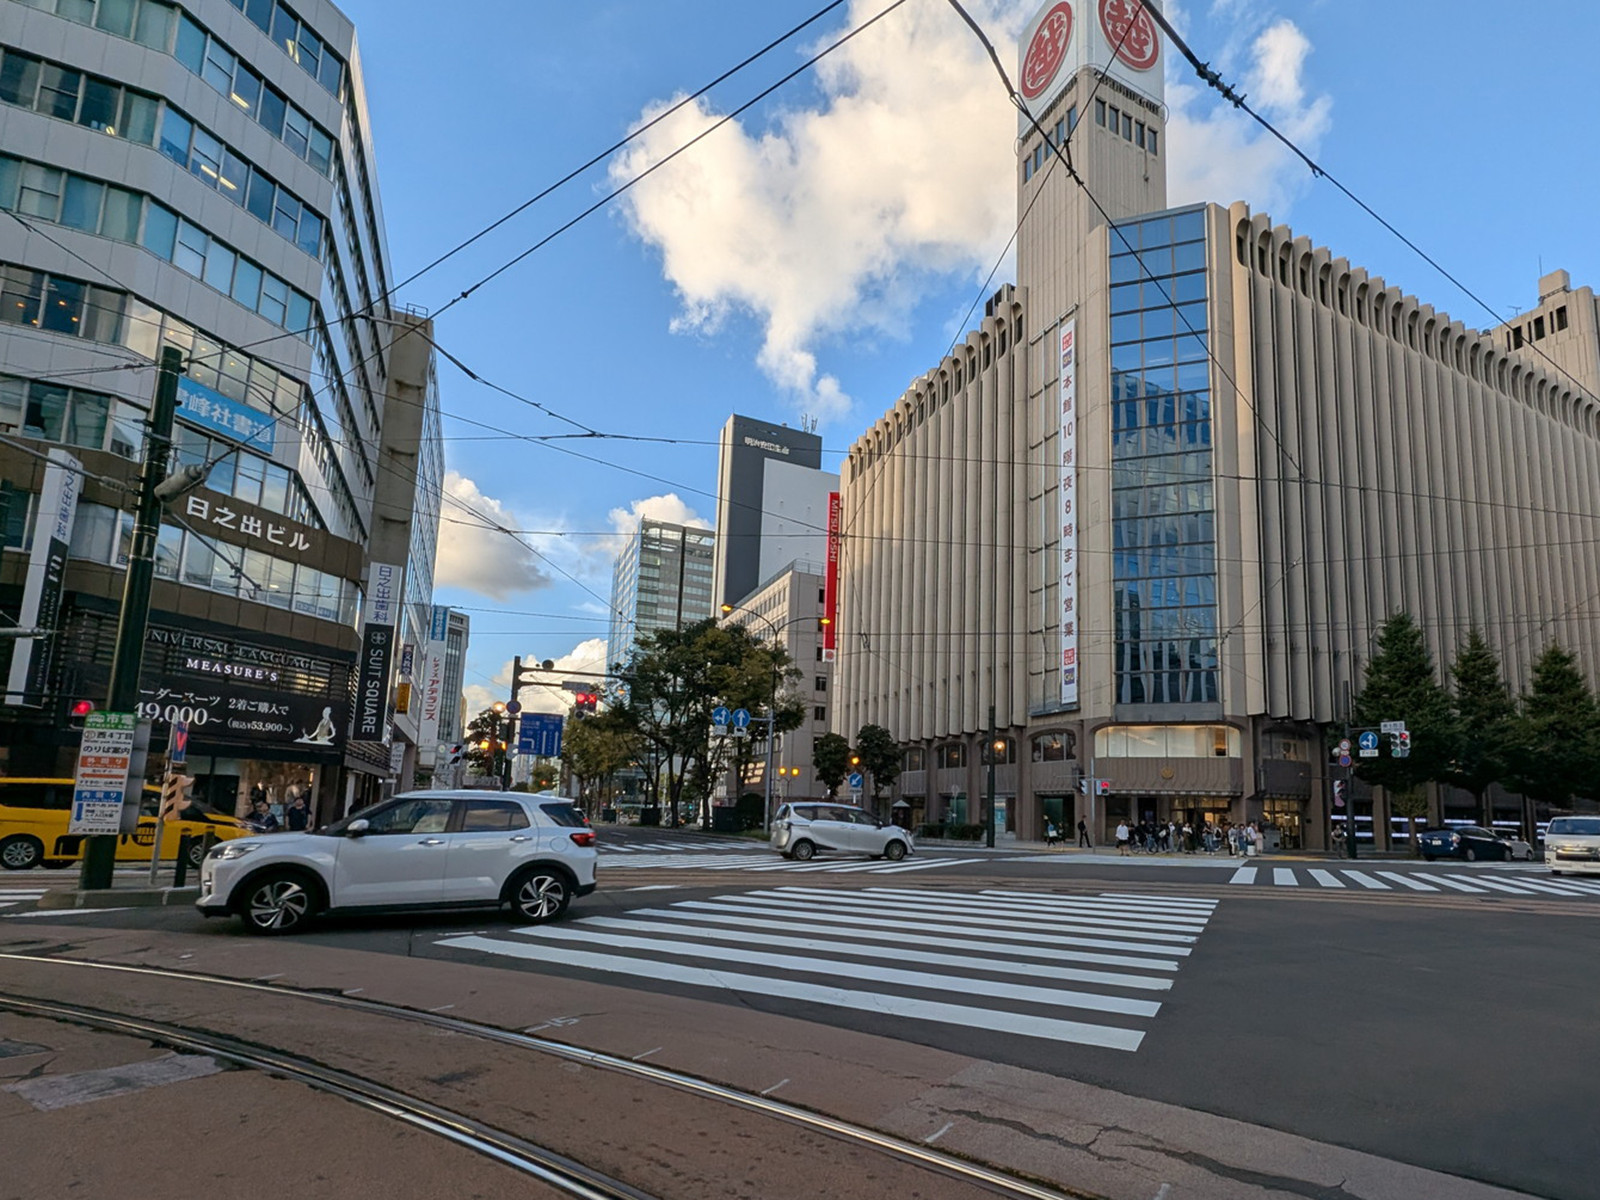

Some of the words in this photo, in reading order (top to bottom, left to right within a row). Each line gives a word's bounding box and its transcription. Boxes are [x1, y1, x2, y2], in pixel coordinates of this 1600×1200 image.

[186, 495, 311, 551] 日之出ビル
[373, 564, 392, 624] 日之出歯科
[186, 657, 279, 682] MEASURE'S
[369, 648, 384, 678] SUIT
[228, 698, 290, 715] 2着ご購入で
[361, 681, 380, 734] SQUARE
